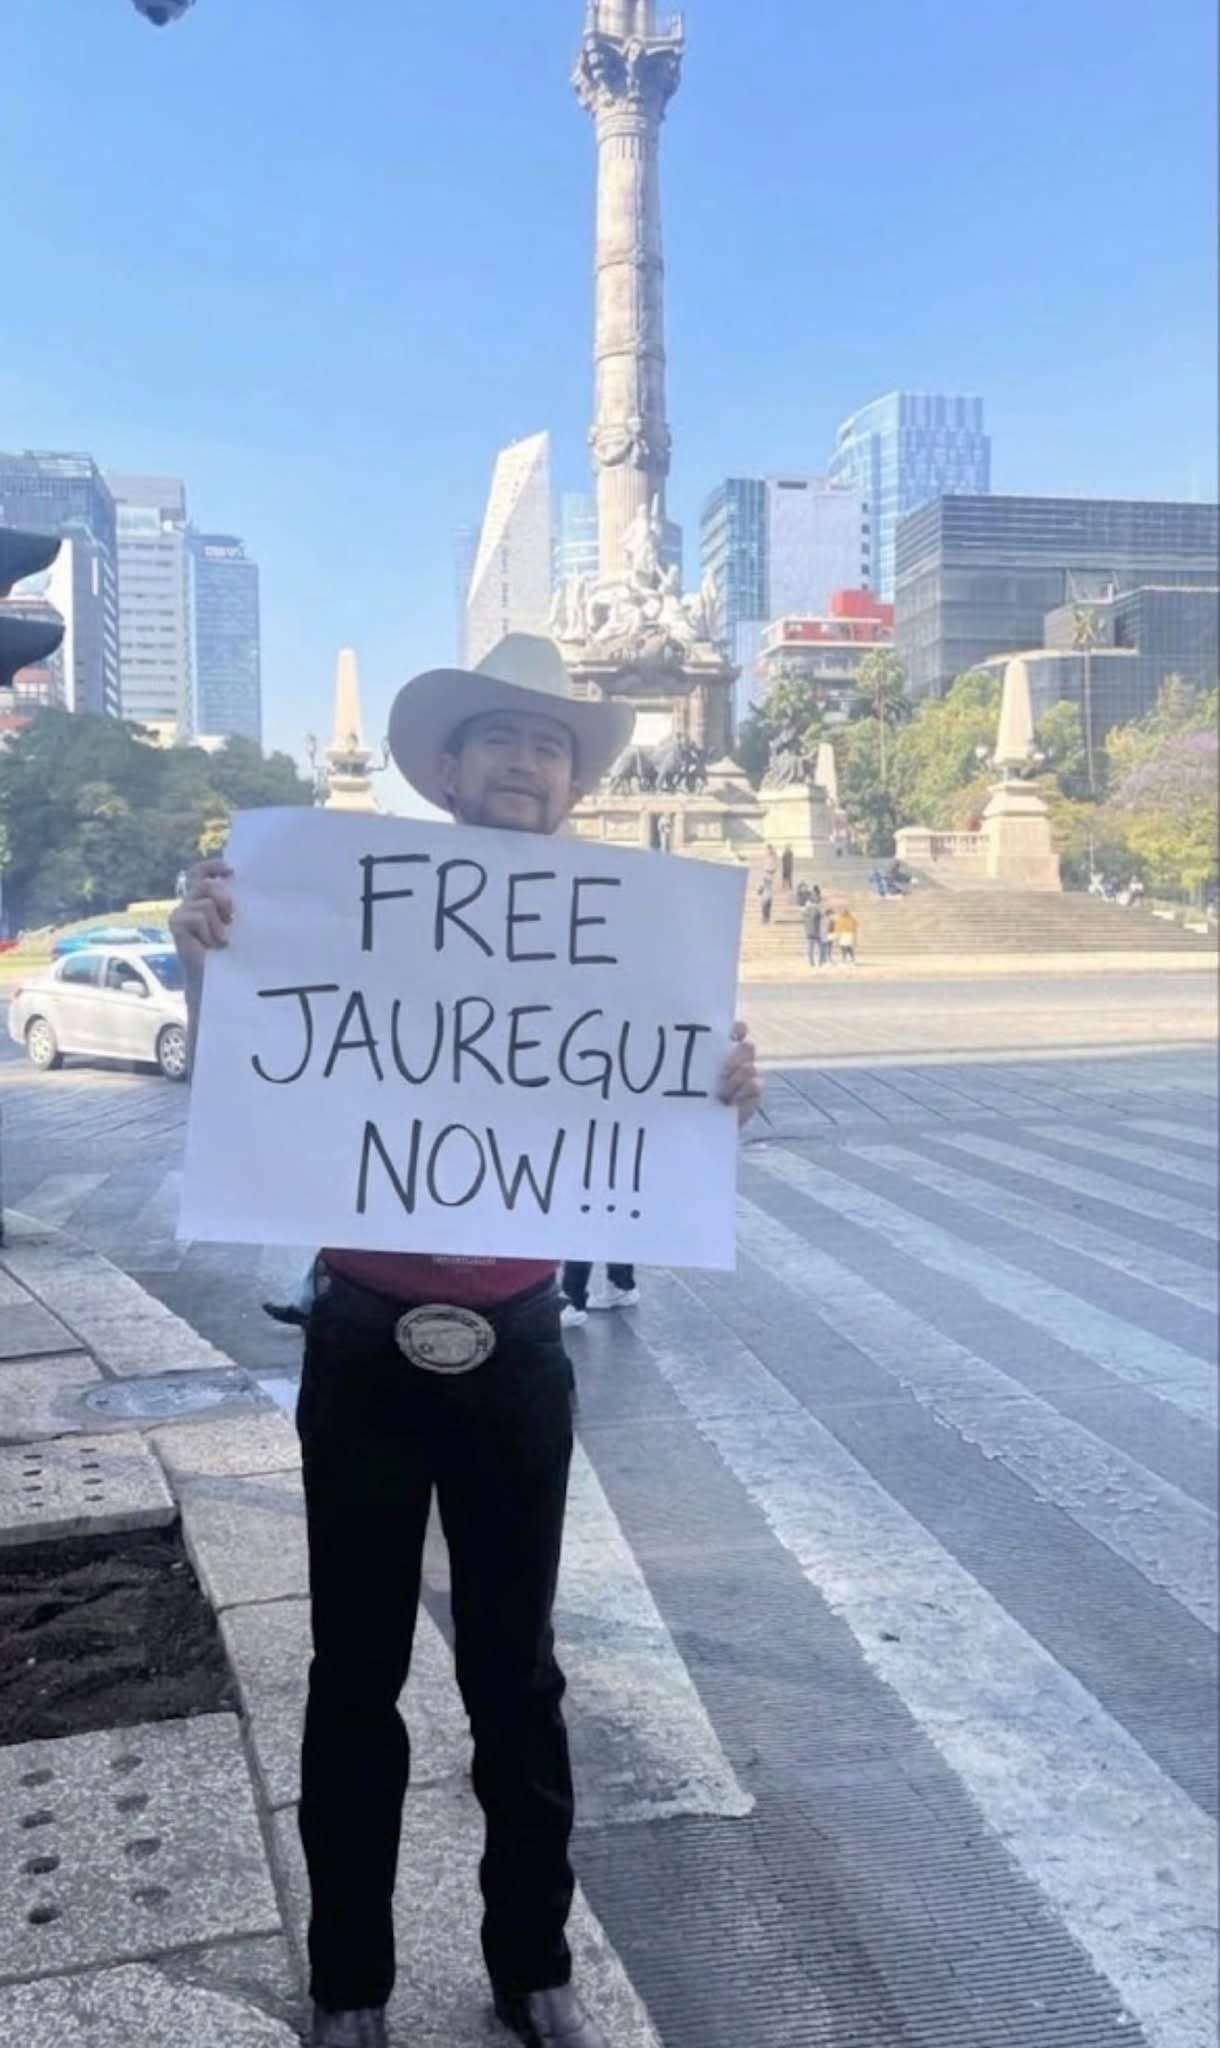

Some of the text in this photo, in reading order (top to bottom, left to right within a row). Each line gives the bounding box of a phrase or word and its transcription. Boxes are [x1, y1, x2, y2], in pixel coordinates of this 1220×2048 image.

[358, 853, 621, 965] FREE
[251, 984, 712, 1100] JAUREGUI
[356, 1118, 645, 1219] NOW!!!
